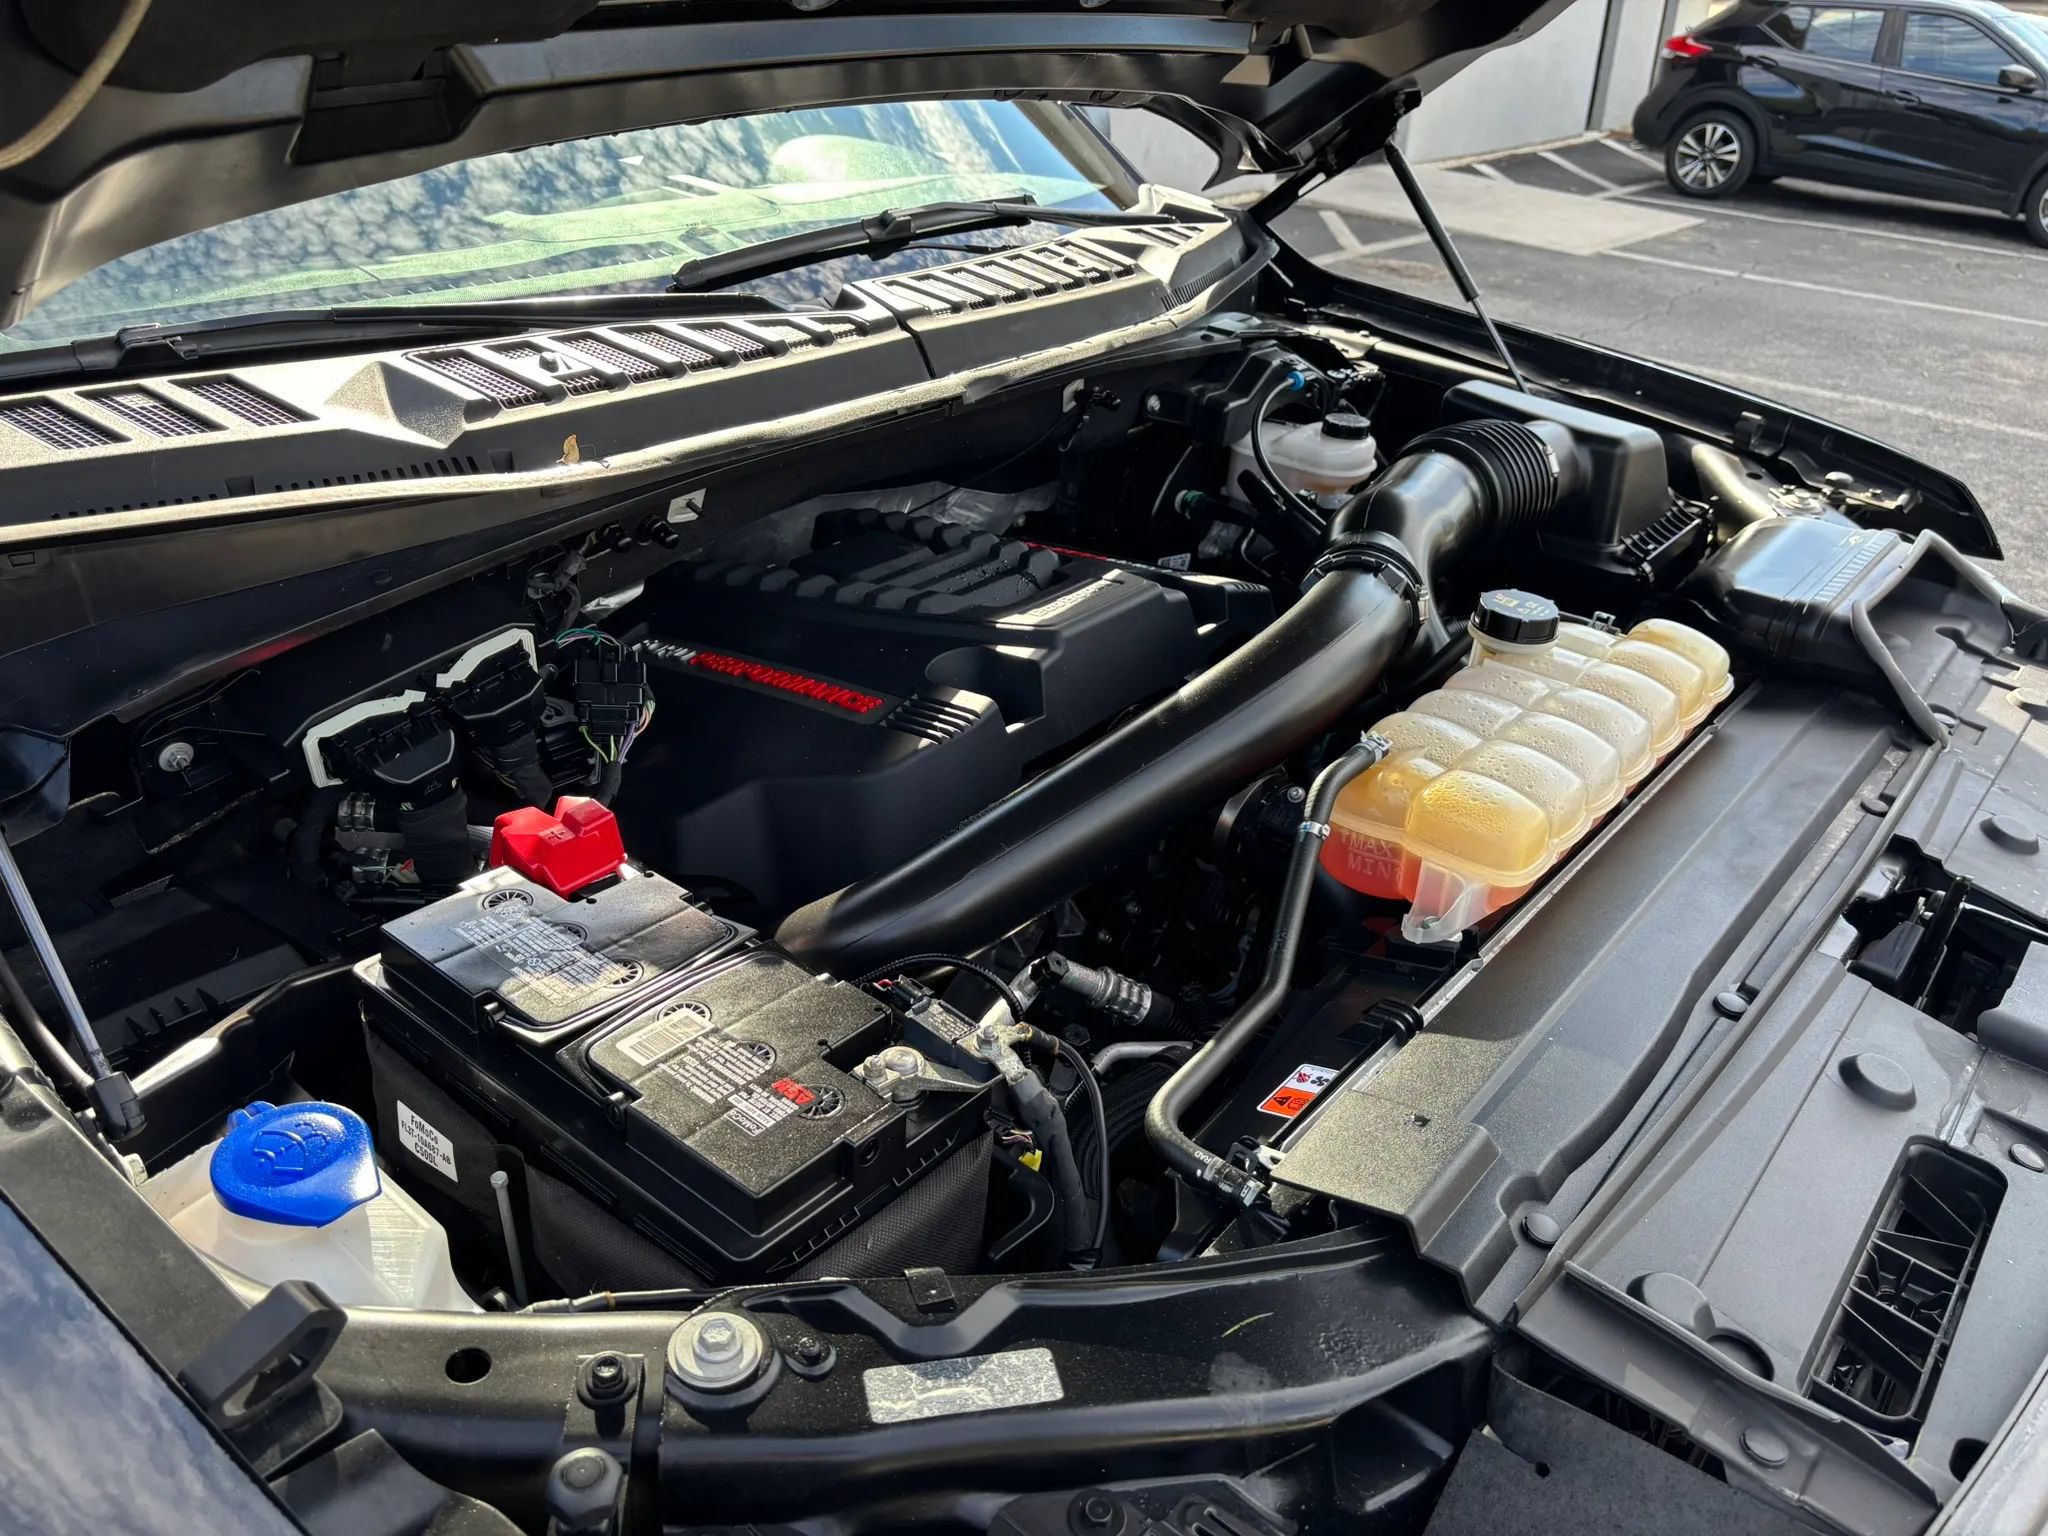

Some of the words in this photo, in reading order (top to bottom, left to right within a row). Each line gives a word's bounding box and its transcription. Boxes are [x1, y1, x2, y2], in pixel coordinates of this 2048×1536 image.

[1350, 831, 1394, 858] MAX
[1347, 852, 1392, 879] MIN
[410, 1114, 439, 1145] FoMoCo
[730, 1109, 760, 1134] FoMoCo
[1194, 1151, 1212, 1164] RAD
